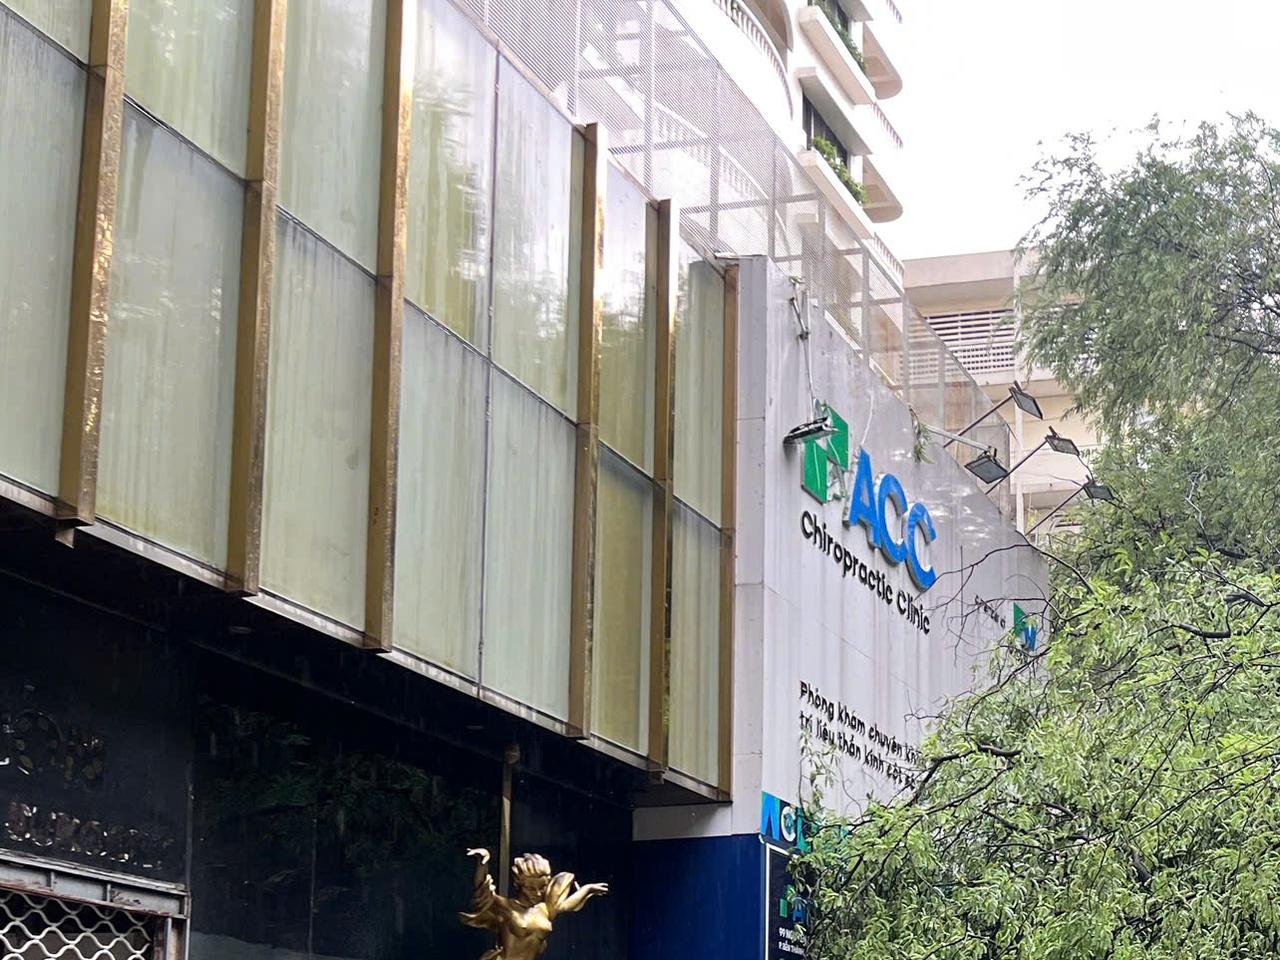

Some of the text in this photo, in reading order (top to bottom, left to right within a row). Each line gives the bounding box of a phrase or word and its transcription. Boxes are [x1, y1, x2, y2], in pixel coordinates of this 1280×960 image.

[848, 447, 937, 590] ACC
[801, 510, 894, 606] Chiropractic
[897, 589, 931, 635] Clinic
[837, 701, 866, 737] khám
[863, 745, 885, 775] kinh
